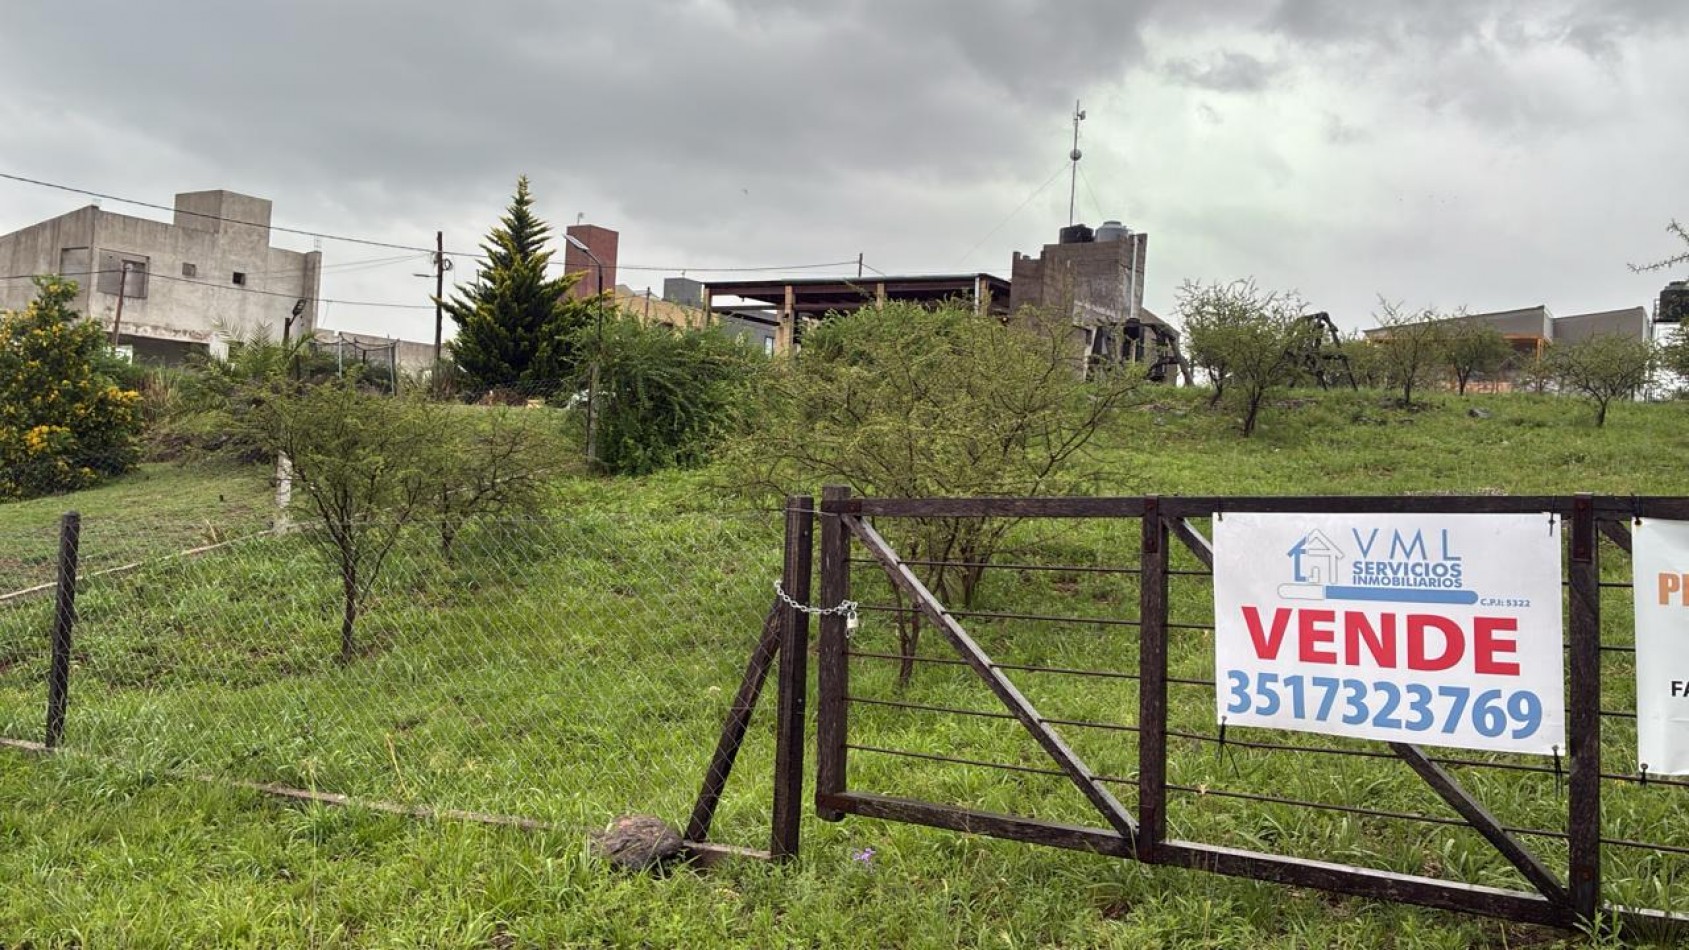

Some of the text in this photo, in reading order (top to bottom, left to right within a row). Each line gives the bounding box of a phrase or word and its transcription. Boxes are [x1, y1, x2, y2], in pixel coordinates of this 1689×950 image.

[1352, 528, 1461, 560] VML
[1352, 561, 1462, 578] SERVICIOS
[1353, 575, 1462, 588] INMOBILIARIOS
[1241, 606, 1520, 676] VENDE
[1227, 670, 1542, 739] 3517323769
